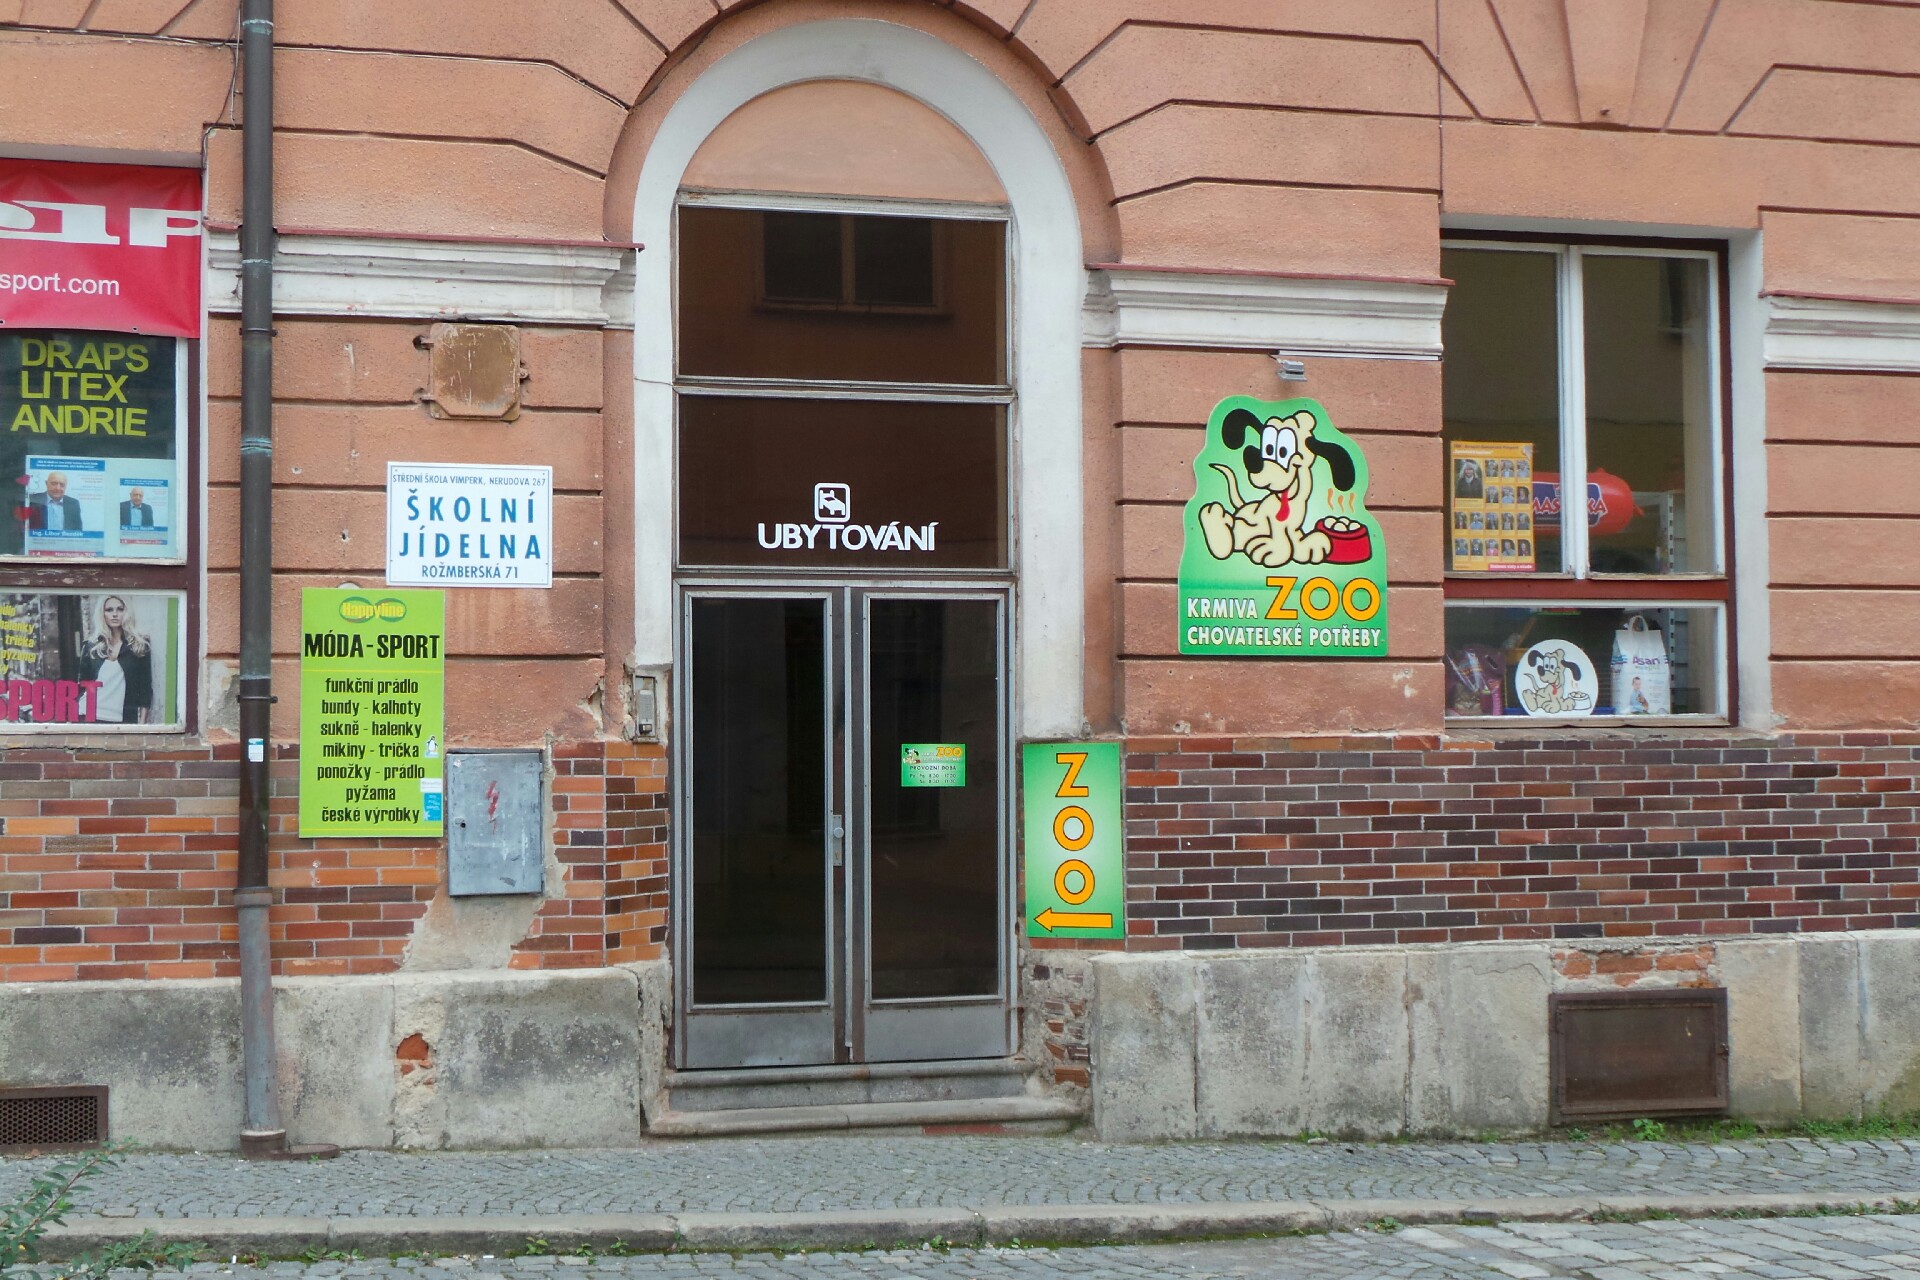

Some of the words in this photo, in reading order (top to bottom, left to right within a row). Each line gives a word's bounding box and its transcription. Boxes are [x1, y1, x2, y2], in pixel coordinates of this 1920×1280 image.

[21, 338, 149, 373] DRAPS
[21, 371, 129, 404] LITEX
[10, 404, 148, 437] ANDRIE
[393, 473, 423, 484] STŘEDNÍ
[424, 473, 449, 484] ŠKOLA
[489, 476, 530, 487] NERUDOVA
[532, 478, 546, 487] 267
[407, 488, 535, 524] ŠKOLNÍ
[399, 525, 541, 559] JÍDELNA
[757, 521, 940, 551] UBYTOVÁNÍ
[421, 562, 502, 579] ROŽMBERSKÁ
[505, 566, 519, 579] 71
[1186, 597, 1259, 620] KRMIVA
[1264, 576, 1381, 621] ZOO
[304, 630, 364, 658] MÓDA
[377, 634, 440, 659] SPORT
[1186, 623, 1303, 647] CHOVATELSKÉ
[1309, 624, 1382, 648] POTŘEBY
[325, 678, 374, 694] funkční
[377, 678, 419, 695] prádlo
[321, 700, 360, 717] bundy
[372, 700, 422, 717] kalhoty
[320, 720, 360, 736] sukně
[371, 721, 422, 738] halenky
[322, 742, 366, 760] mikiny
[378, 742, 420, 758] trička
[936, 746, 962, 757] ZOO
[317, 763, 372, 781] ponožky
[384, 764, 425, 781] prádlo
[346, 785, 396, 803] pyžama
[321, 806, 361, 822] české
[365, 807, 420, 824] výrobky
[1053, 752, 1096, 906] ZOO
